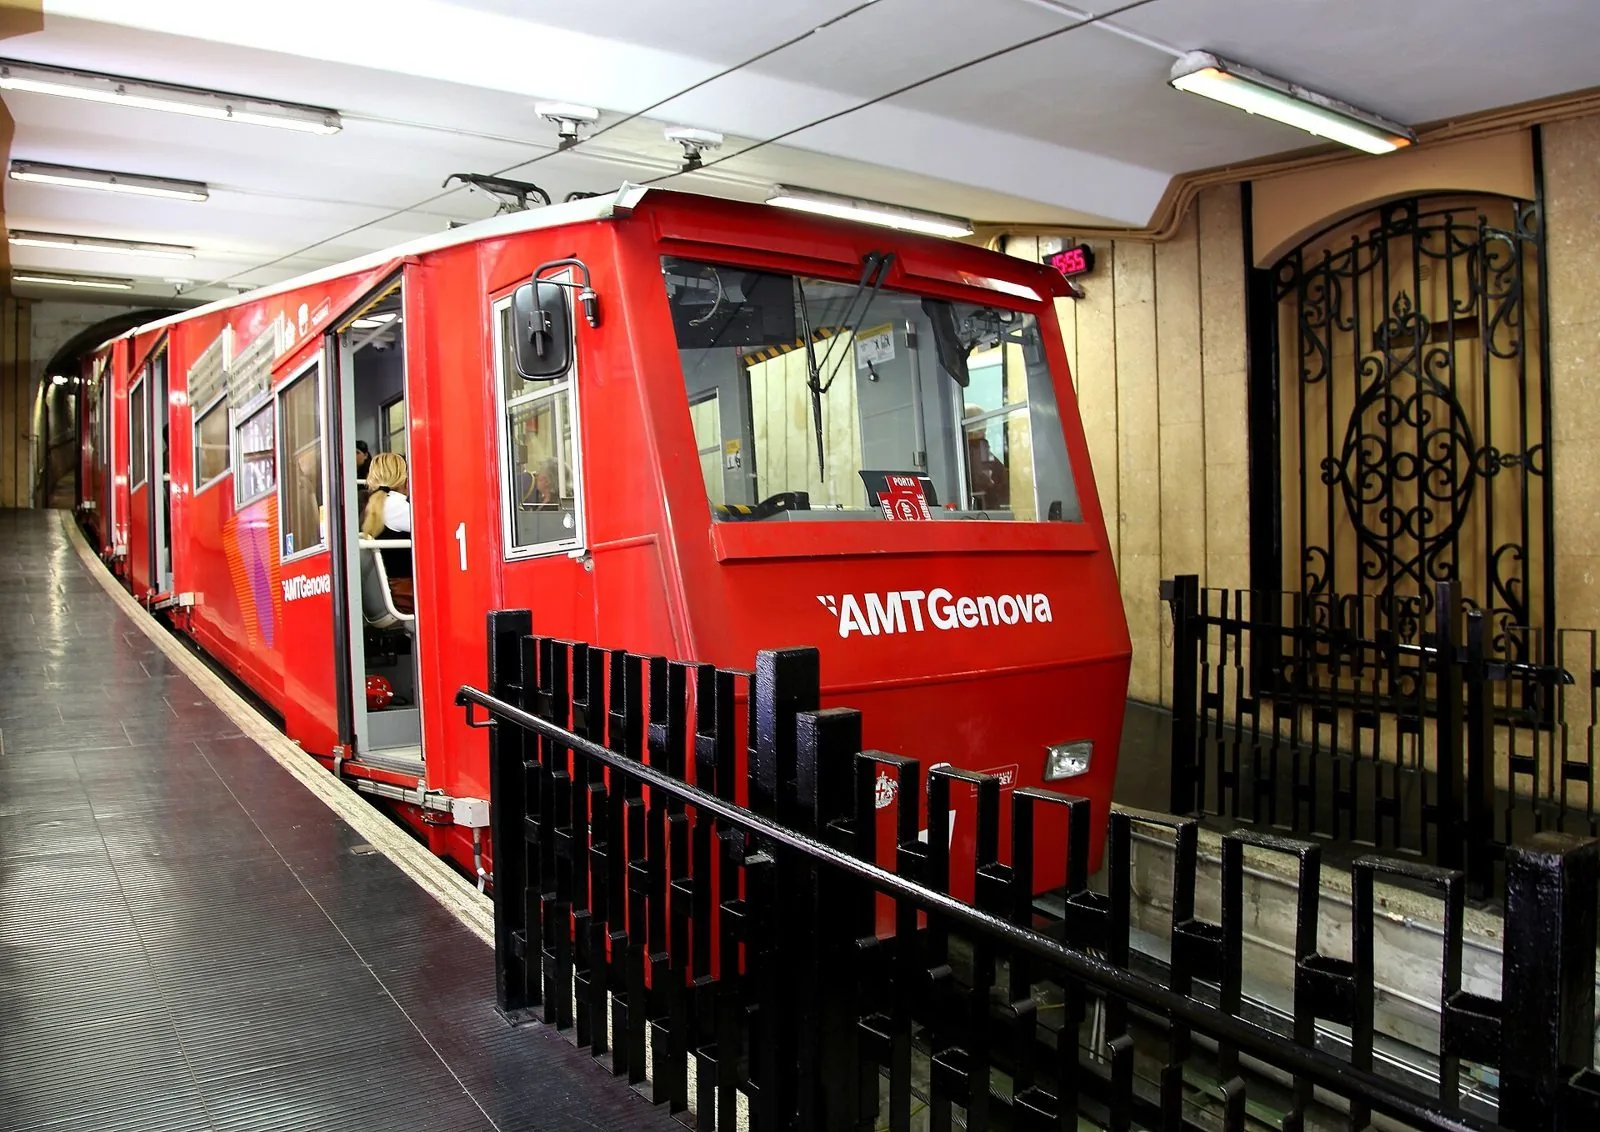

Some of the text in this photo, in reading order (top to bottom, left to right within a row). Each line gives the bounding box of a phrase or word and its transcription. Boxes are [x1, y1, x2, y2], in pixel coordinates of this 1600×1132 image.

[893, 477, 915, 487] PORTA
[881, 499, 895, 521] ORTA
[455, 522, 468, 571] 1
